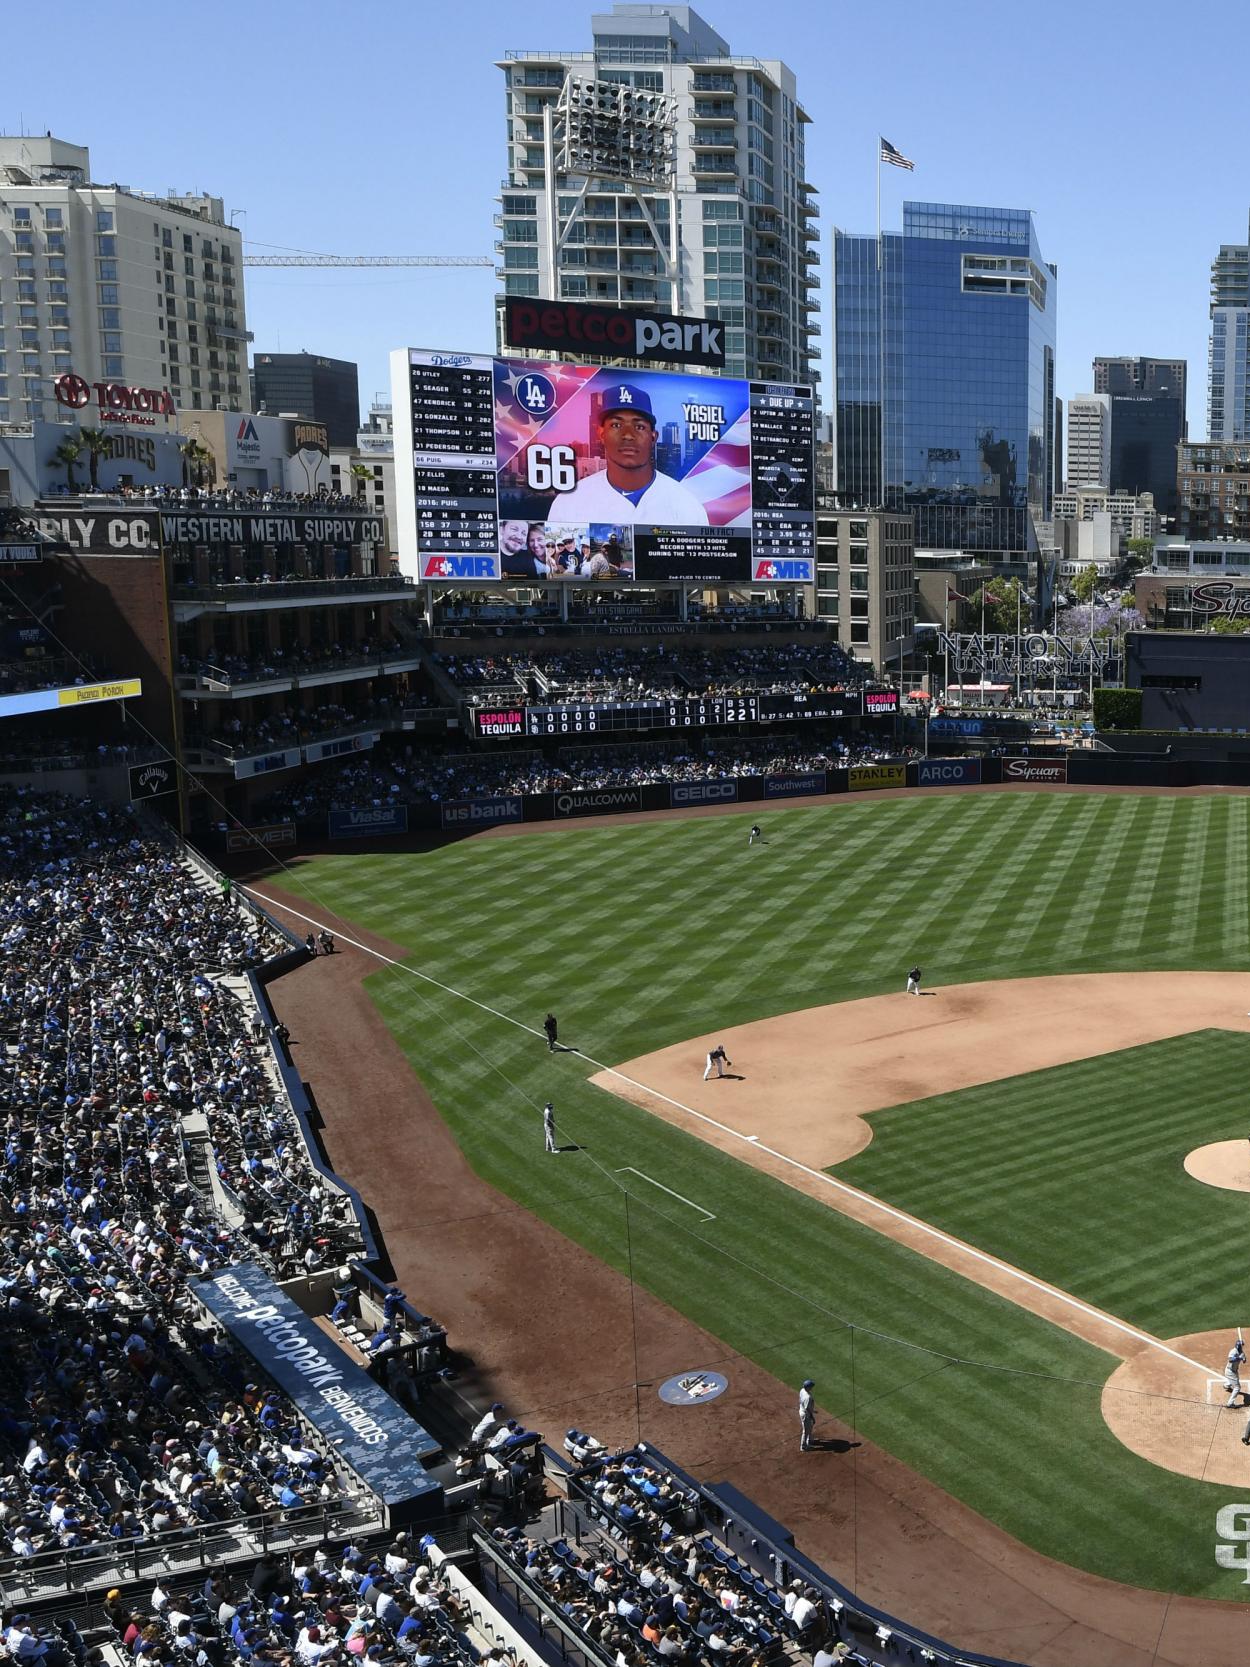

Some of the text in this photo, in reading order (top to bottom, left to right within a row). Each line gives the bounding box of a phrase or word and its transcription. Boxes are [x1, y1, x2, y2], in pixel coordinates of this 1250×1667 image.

[431, 355, 472, 366] Dodgers
[93, 383, 176, 415] TOYOTA
[526, 379, 545, 407] LA
[770, 397, 793, 407] DUE UP
[682, 404, 725, 424] YASIEL
[294, 425, 327, 450] PADRES
[689, 423, 718, 441] PUIG
[527, 444, 575, 490] 66
[108, 519, 159, 549] CO.
[162, 517, 383, 542] WESTERN METAL SUPPLY CO.
[425, 557, 495, 576] AMR
[756, 561, 809, 578] AMR
[937, 632, 1122, 660] NATIONAL
[952, 657, 1108, 676] UNIVERSITY
[867, 704, 896, 712] TEQUILA
[481, 724, 521, 734] TEQUILA
[139, 768, 168, 786] Callaway
[850, 768, 903, 781] STANLEY
[921, 766, 963, 779] ARCO
[1006, 760, 1065, 781] Sycuan
[674, 783, 735, 800] GEICO
[769, 779, 816, 791] Southwest
[558, 795, 638, 813] QUALCOMM
[350, 810, 395, 824] ViaSat
[228, 829, 294, 848] CYMER
[213, 1274, 258, 1310] WELCOME
[319, 1385, 388, 1444] BIENVENIDOS
